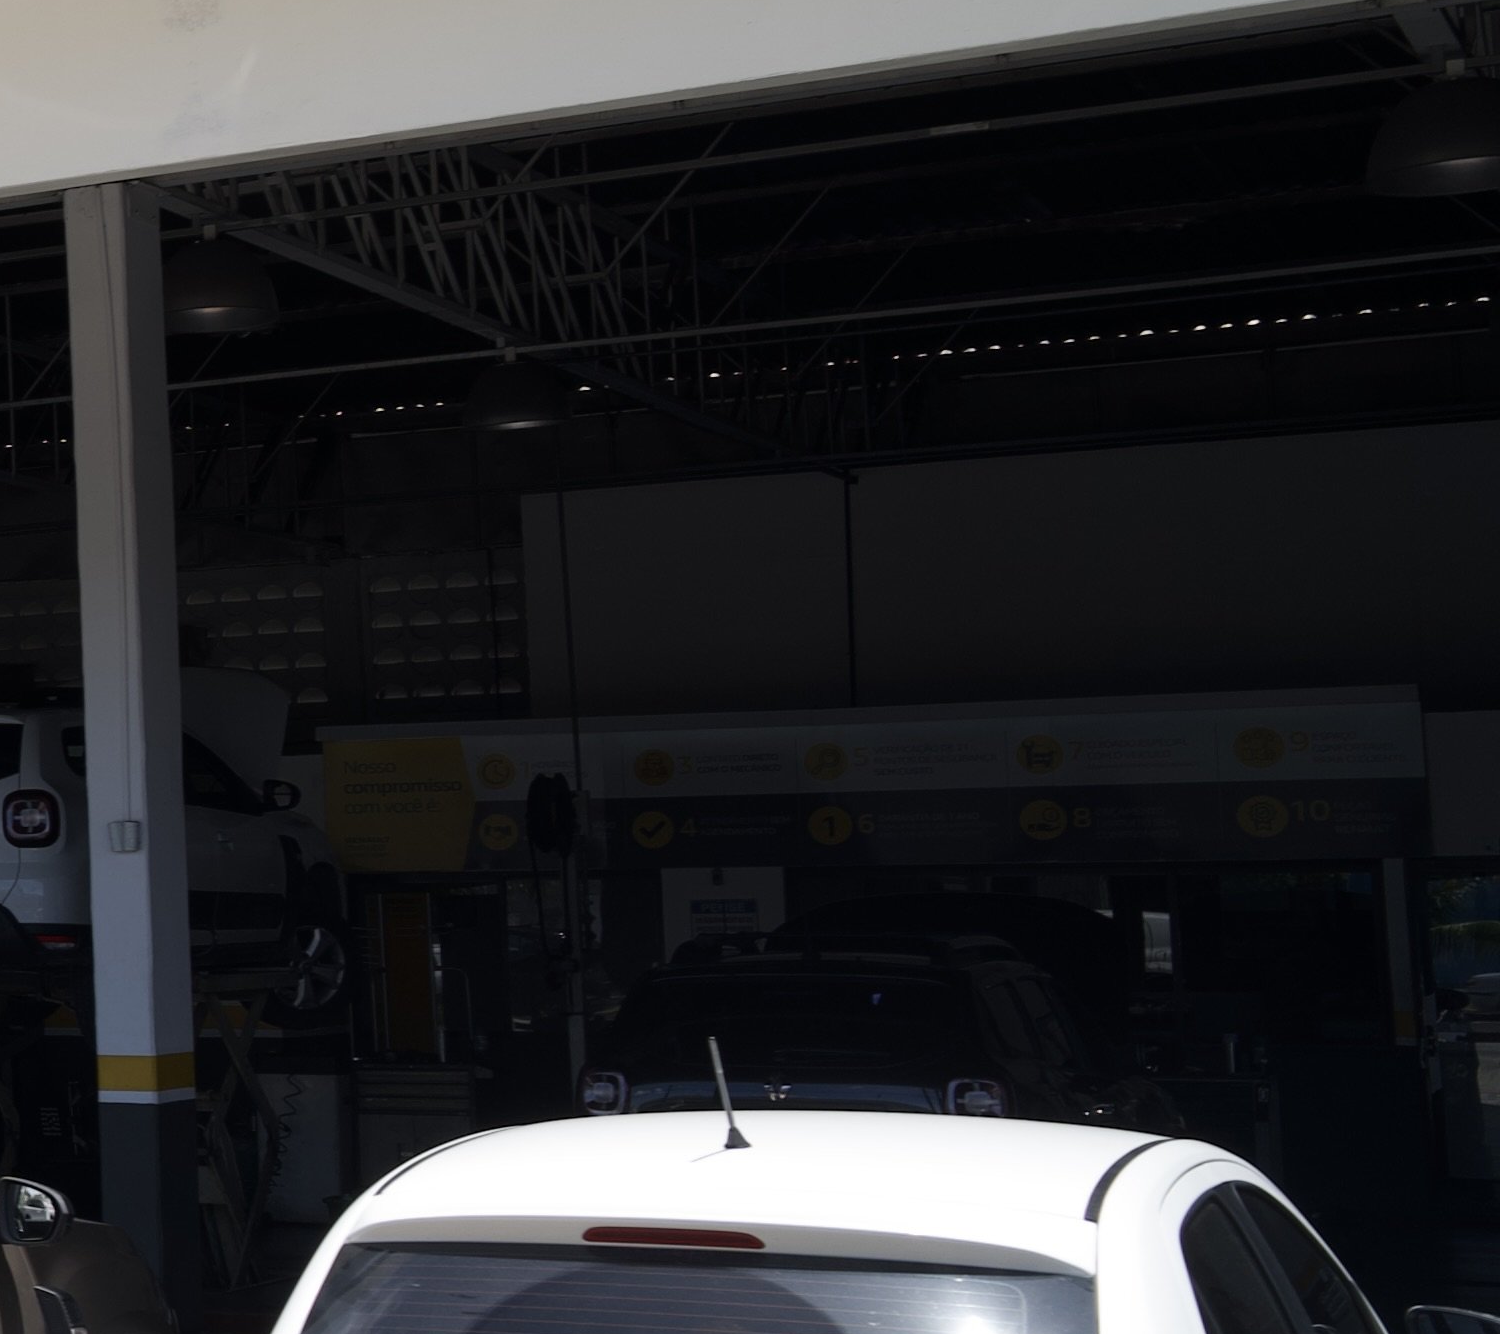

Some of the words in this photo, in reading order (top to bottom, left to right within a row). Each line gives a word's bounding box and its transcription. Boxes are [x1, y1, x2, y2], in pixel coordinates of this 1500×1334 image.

[1290, 731, 1309, 752] 9
[853, 747, 869, 767] 5
[343, 761, 397, 774] Nosso
[343, 777, 463, 797] compromisso
[1073, 808, 1092, 828] 8
[1290, 800, 1331, 822] 10
[679, 818, 698, 837] 4
[858, 813, 875, 835] 6
